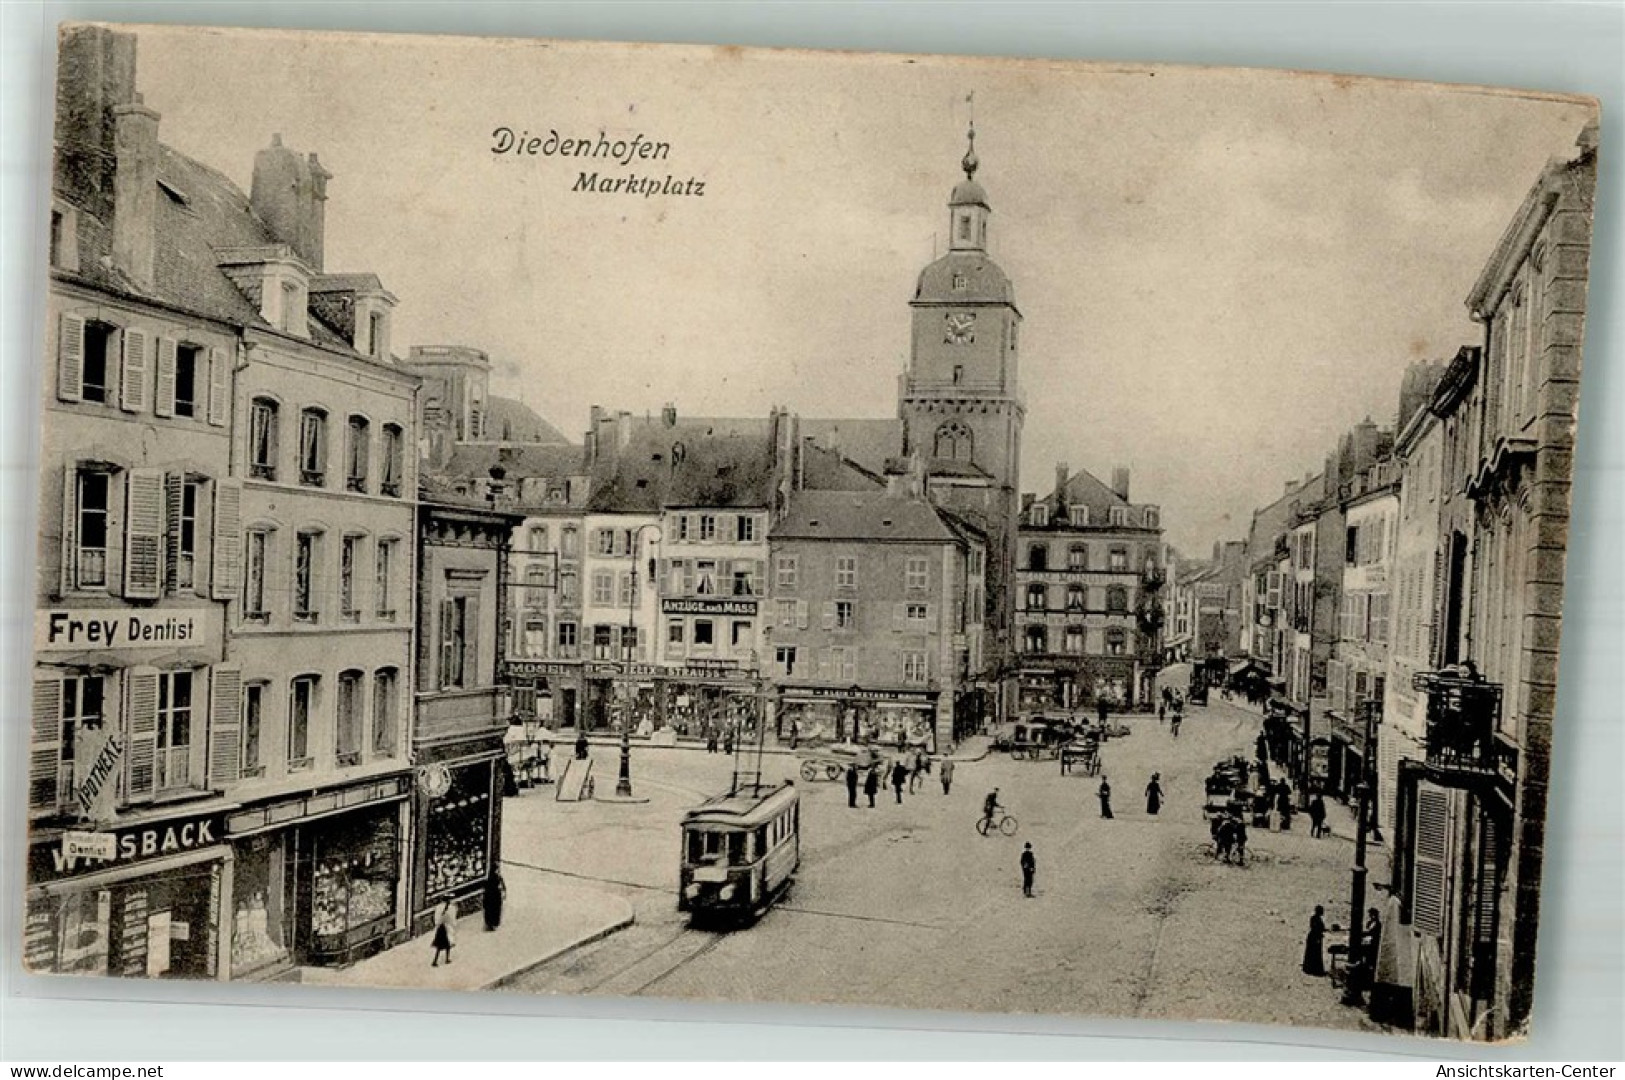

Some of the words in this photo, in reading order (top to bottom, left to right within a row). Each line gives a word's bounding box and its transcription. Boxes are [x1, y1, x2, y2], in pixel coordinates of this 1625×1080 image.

[48, 613, 118, 647] Frey
[128, 617, 193, 641] Dentist
[78, 734, 123, 813] APOTHEKE
